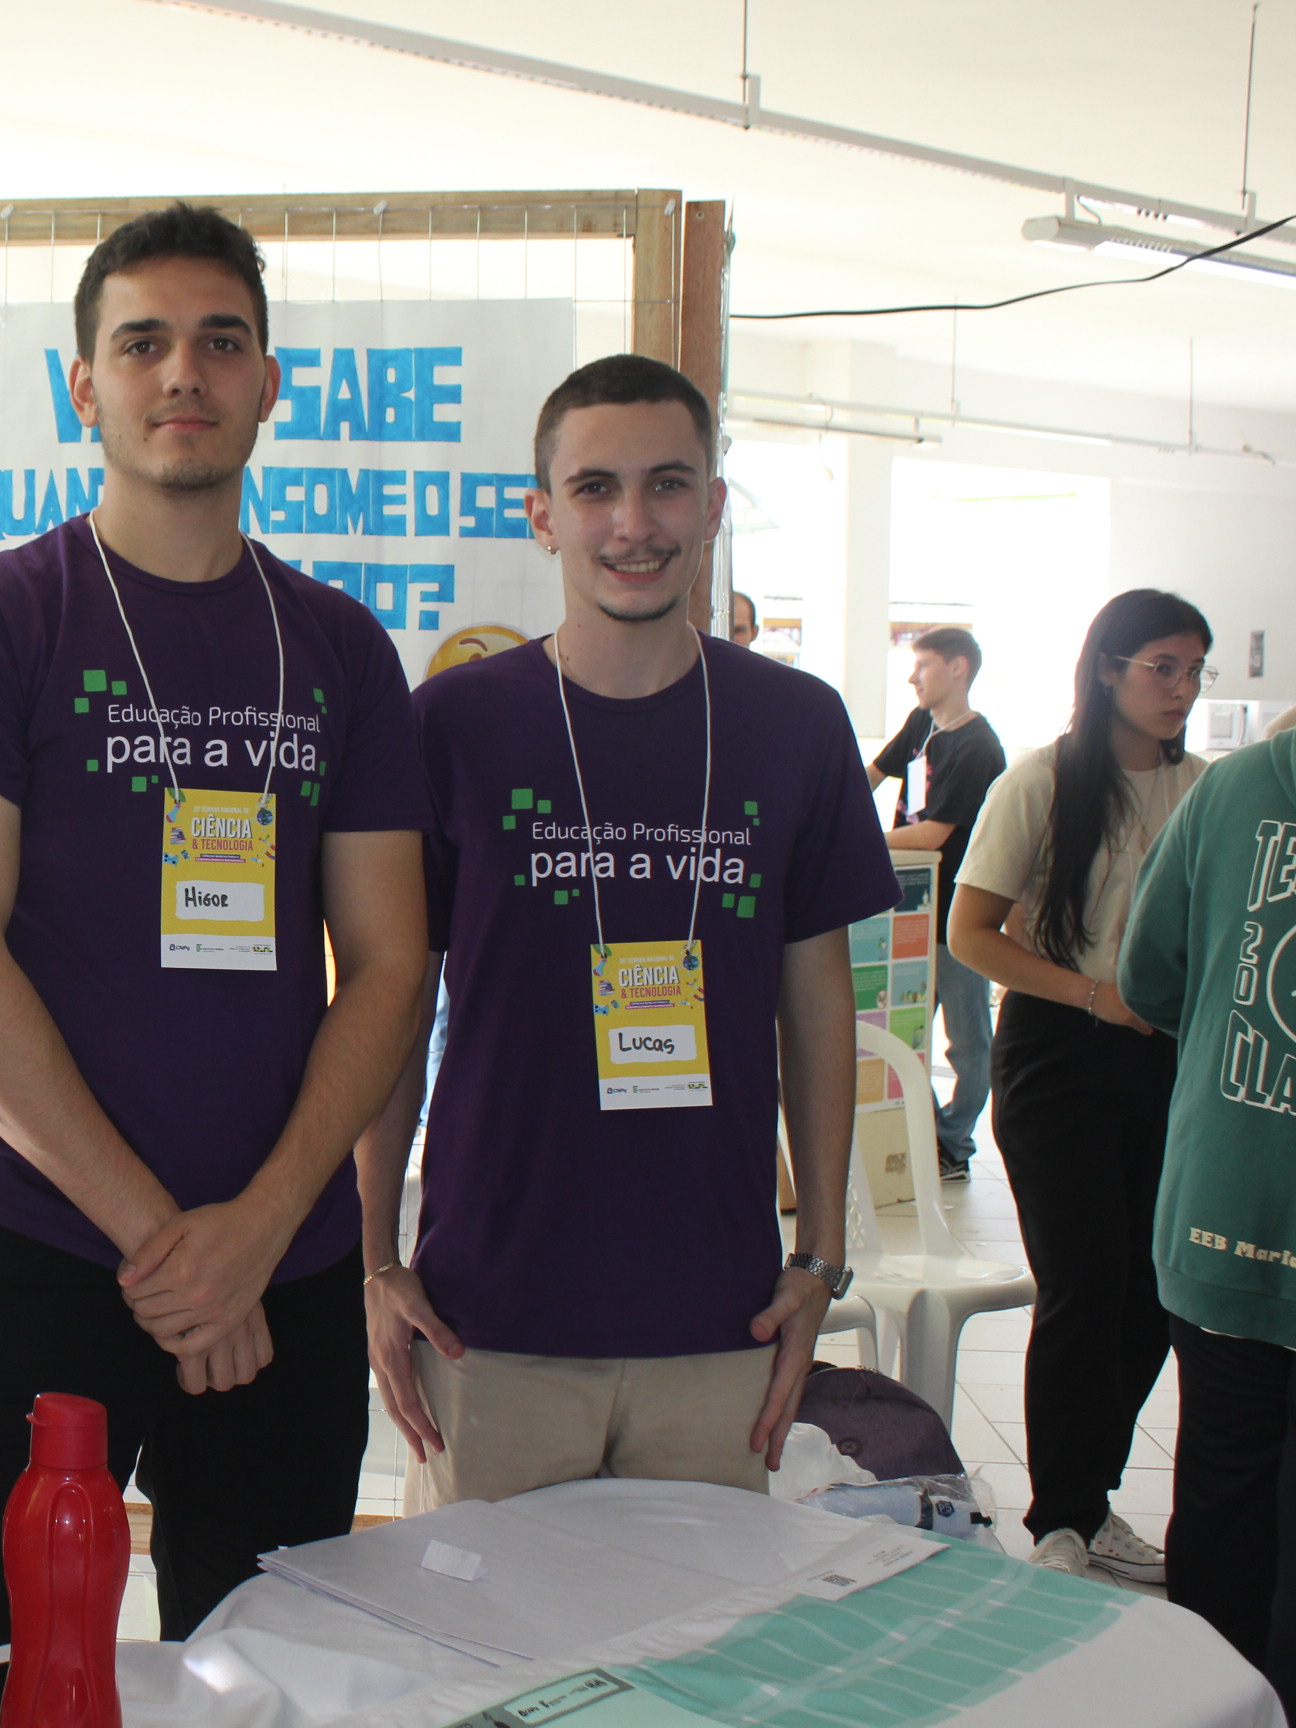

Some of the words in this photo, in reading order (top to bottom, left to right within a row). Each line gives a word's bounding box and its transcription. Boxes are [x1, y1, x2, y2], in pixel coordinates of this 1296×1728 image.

[274, 346, 462, 442] SABE
[239, 465, 407, 536] NSOME
[413, 470, 450, 537] O
[459, 472, 538, 539] SE
[108, 704, 202, 730] Educação
[208, 706, 320, 732] Profissional
[106, 734, 191, 773] para
[204, 739, 228, 767] a
[245, 730, 316, 772] vida
[192, 814, 253, 838] CIÊNCIA
[532, 822, 626, 845] Educação
[633, 822, 751, 846] Profissional
[192, 839, 198, 850] &
[201, 839, 253, 850] TECNOLOGIA
[531, 850, 615, 887] para
[629, 853, 652, 879] a
[666, 847, 744, 884] vida
[619, 964, 680, 987] CIÊNCIA
[621, 988, 627, 999] &
[630, 986, 681, 998] TECNOLOGIA
[618, 1032, 675, 1054] Lucas
[1188, 1227, 1228, 1251] EEB
